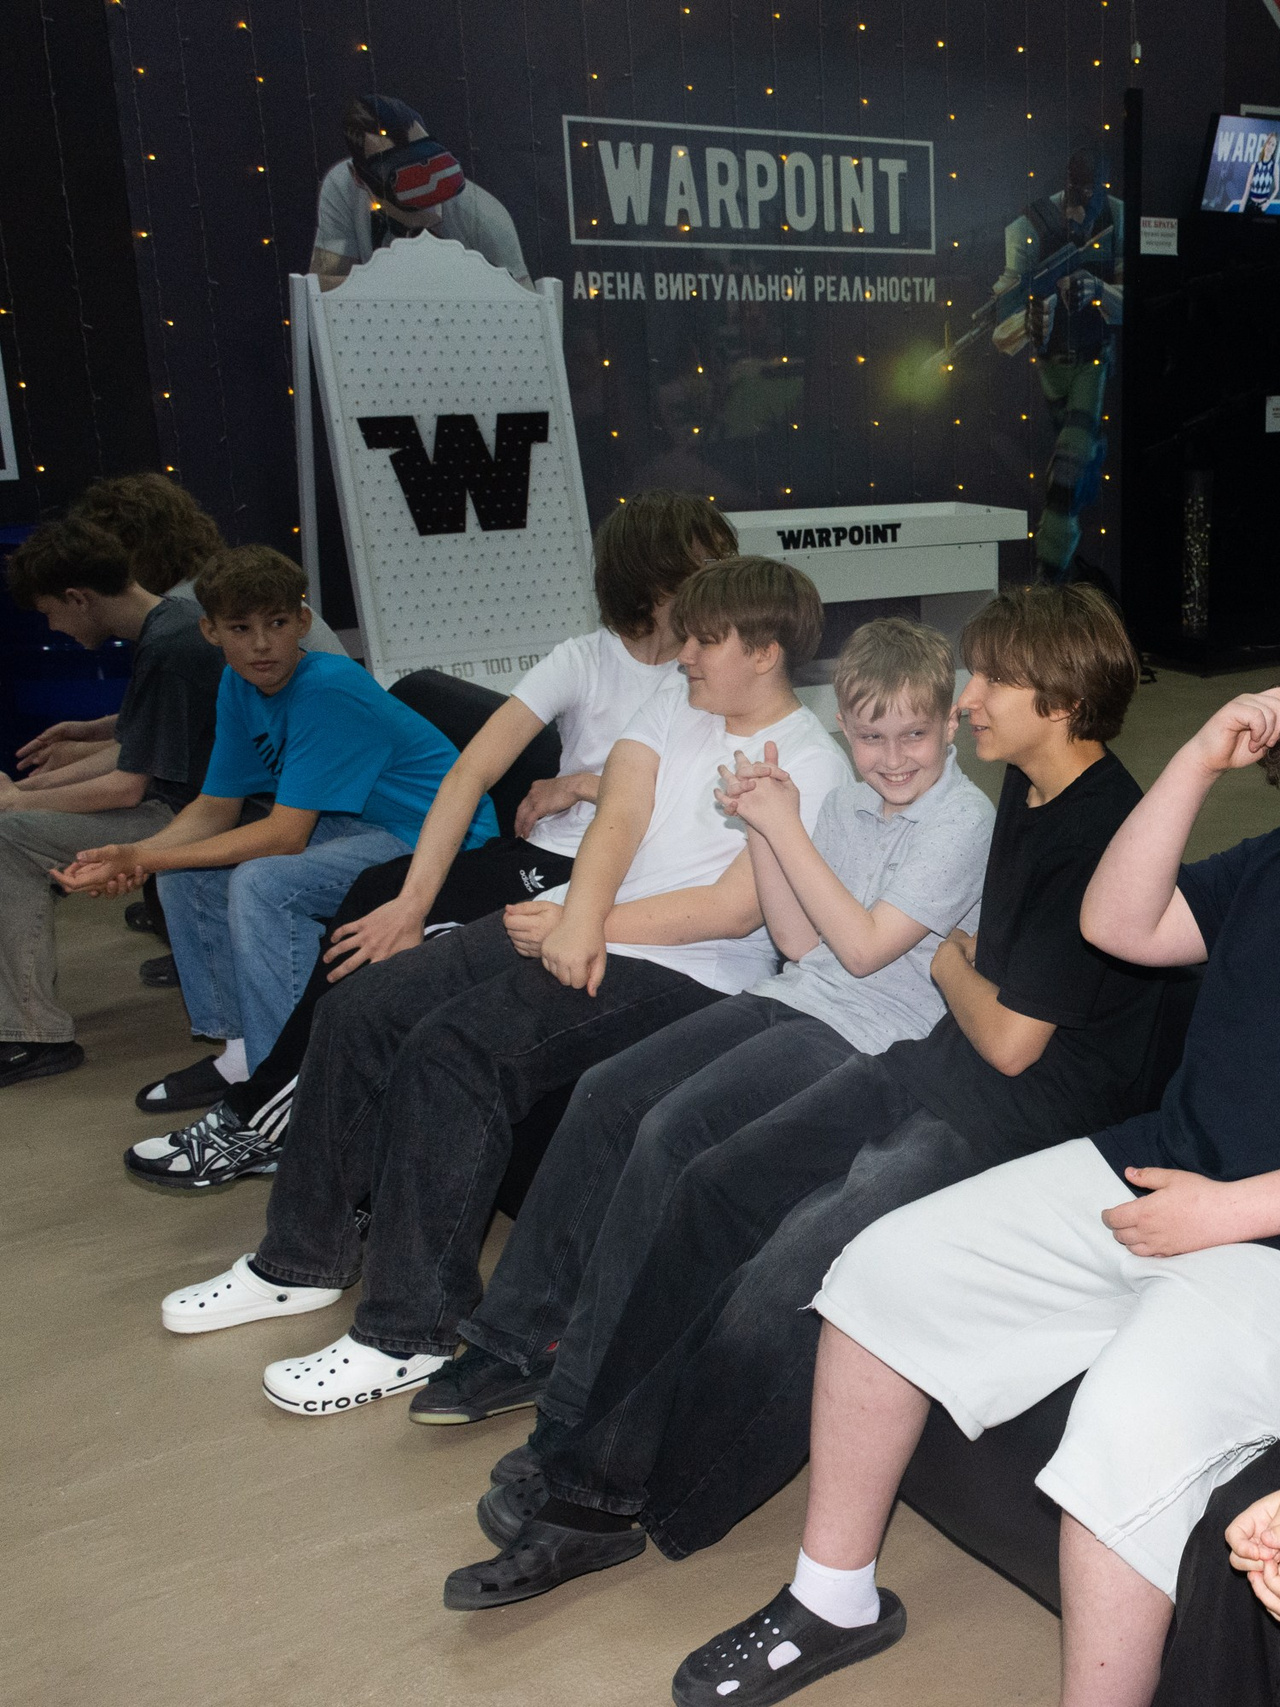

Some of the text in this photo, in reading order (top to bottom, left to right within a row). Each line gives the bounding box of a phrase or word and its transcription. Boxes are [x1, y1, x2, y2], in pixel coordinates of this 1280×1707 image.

[598, 140, 908, 235] WARPOINT
[573, 267, 936, 302] АРЕНА ВИРТУАЛЬНОЙ РЕАЛЬНОСТИ
[451, 661, 475, 679] 60
[482, 657, 513, 676] 100
[303, 1388, 383, 1412] crocs
